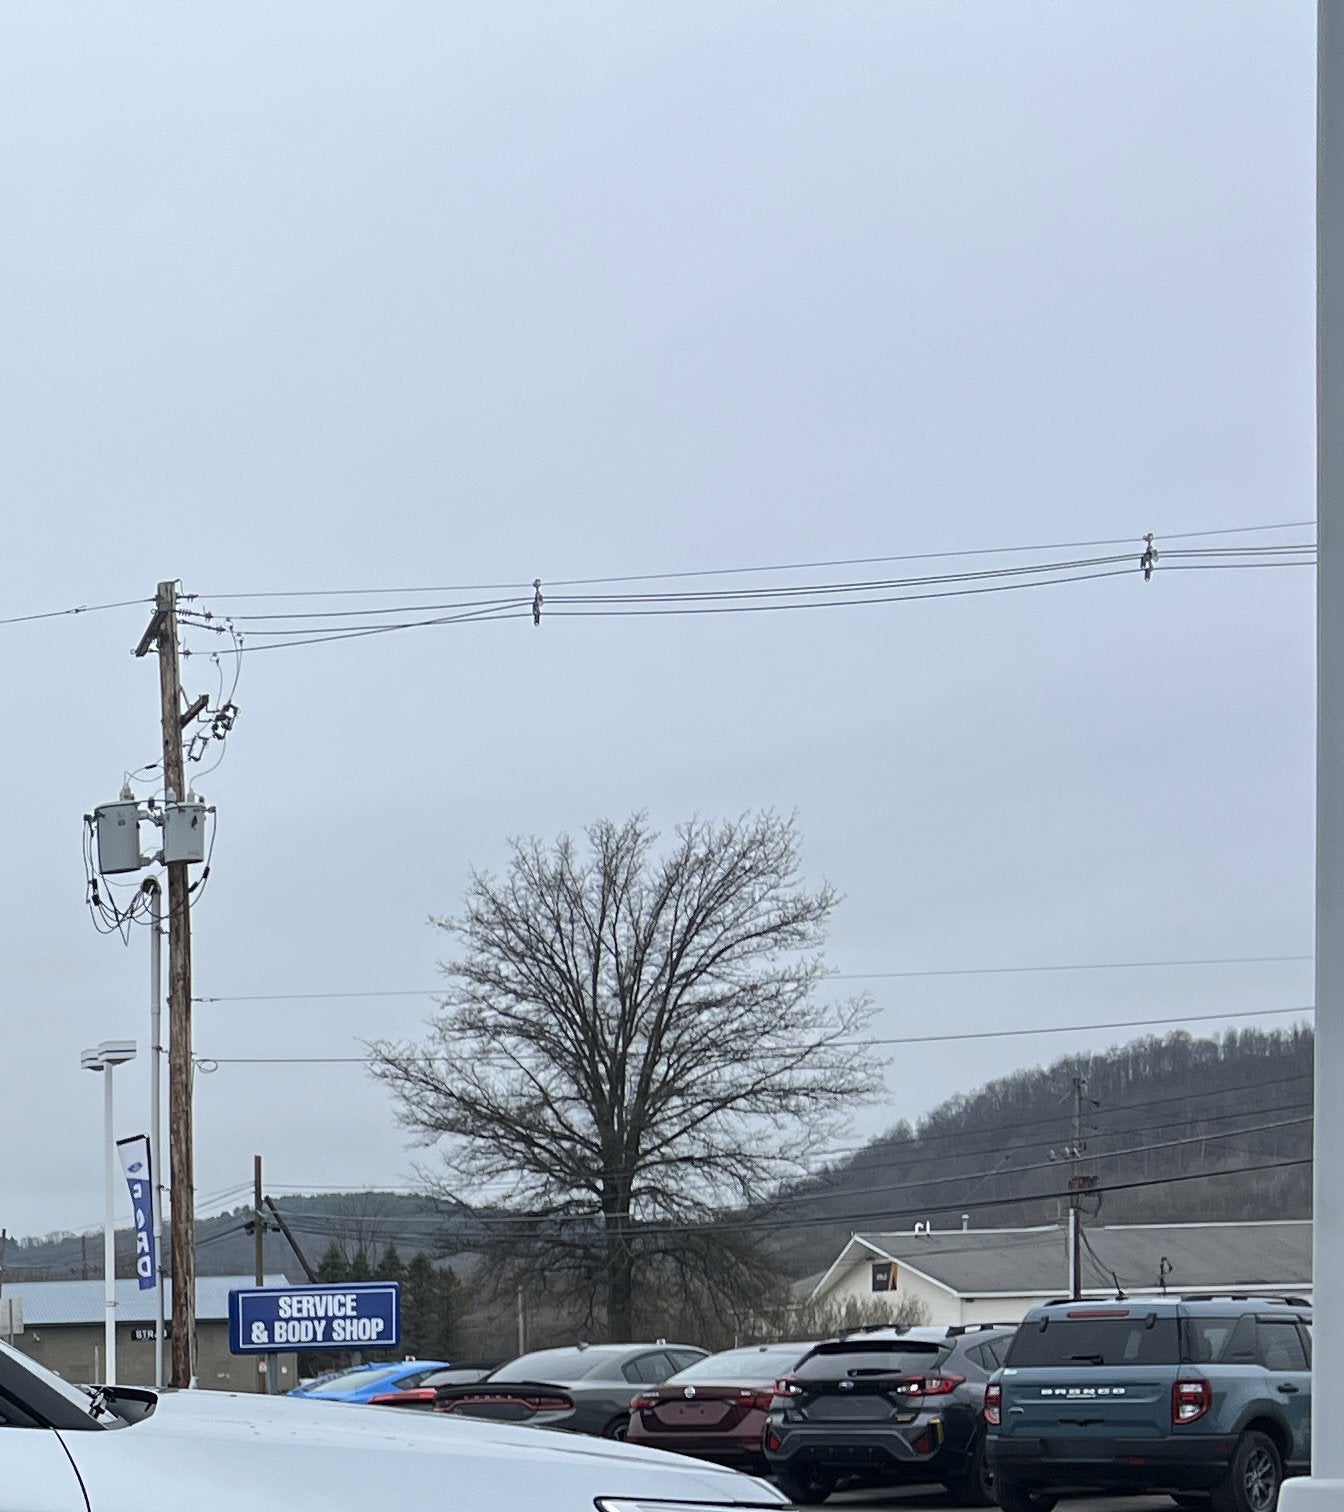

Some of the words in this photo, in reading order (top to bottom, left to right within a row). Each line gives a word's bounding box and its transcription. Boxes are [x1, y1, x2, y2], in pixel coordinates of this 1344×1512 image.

[278, 1294, 358, 1319] SERVICE
[251, 1321, 269, 1344] &
[274, 1319, 326, 1343] BODY
[332, 1317, 385, 1341] SHOP
